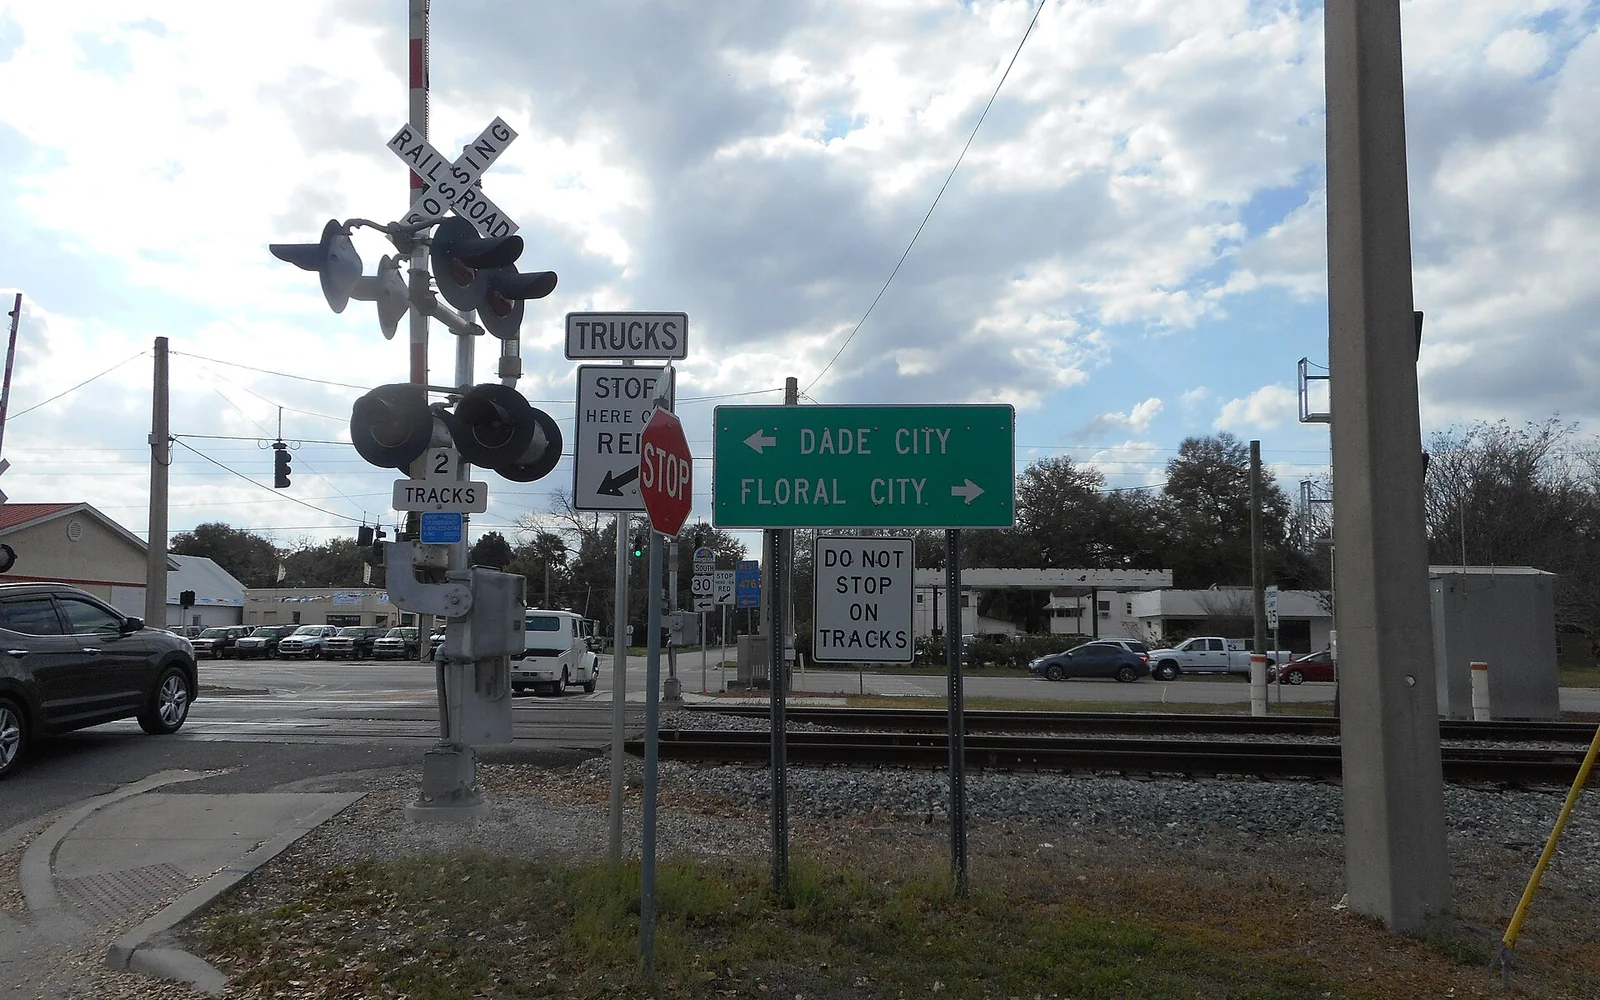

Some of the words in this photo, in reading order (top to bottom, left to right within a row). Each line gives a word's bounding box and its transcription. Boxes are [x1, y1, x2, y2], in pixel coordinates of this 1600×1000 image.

[393, 129, 442, 182] RAIL
[456, 188, 510, 237] ROAD
[576, 321, 677, 350] TRUCKS
[595, 377, 657, 399] STOP
[586, 410, 632, 423] HERE
[642, 410, 651, 423] O
[598, 432, 641, 454] RE
[800, 428, 871, 455] DADE
[895, 428, 951, 455] CITY
[434, 453, 449, 473] 2
[643, 442, 689, 500] STOP
[405, 487, 475, 504] TRACKS
[741, 478, 846, 505] FLORAL
[870, 478, 927, 505] CITY
[695, 563, 714, 572] SOUTH
[824, 549, 852, 567] DO
[862, 550, 904, 568] NOT
[836, 576, 892, 594] STOP
[850, 603, 878, 621] ON
[819, 629, 907, 648] TRACKS
